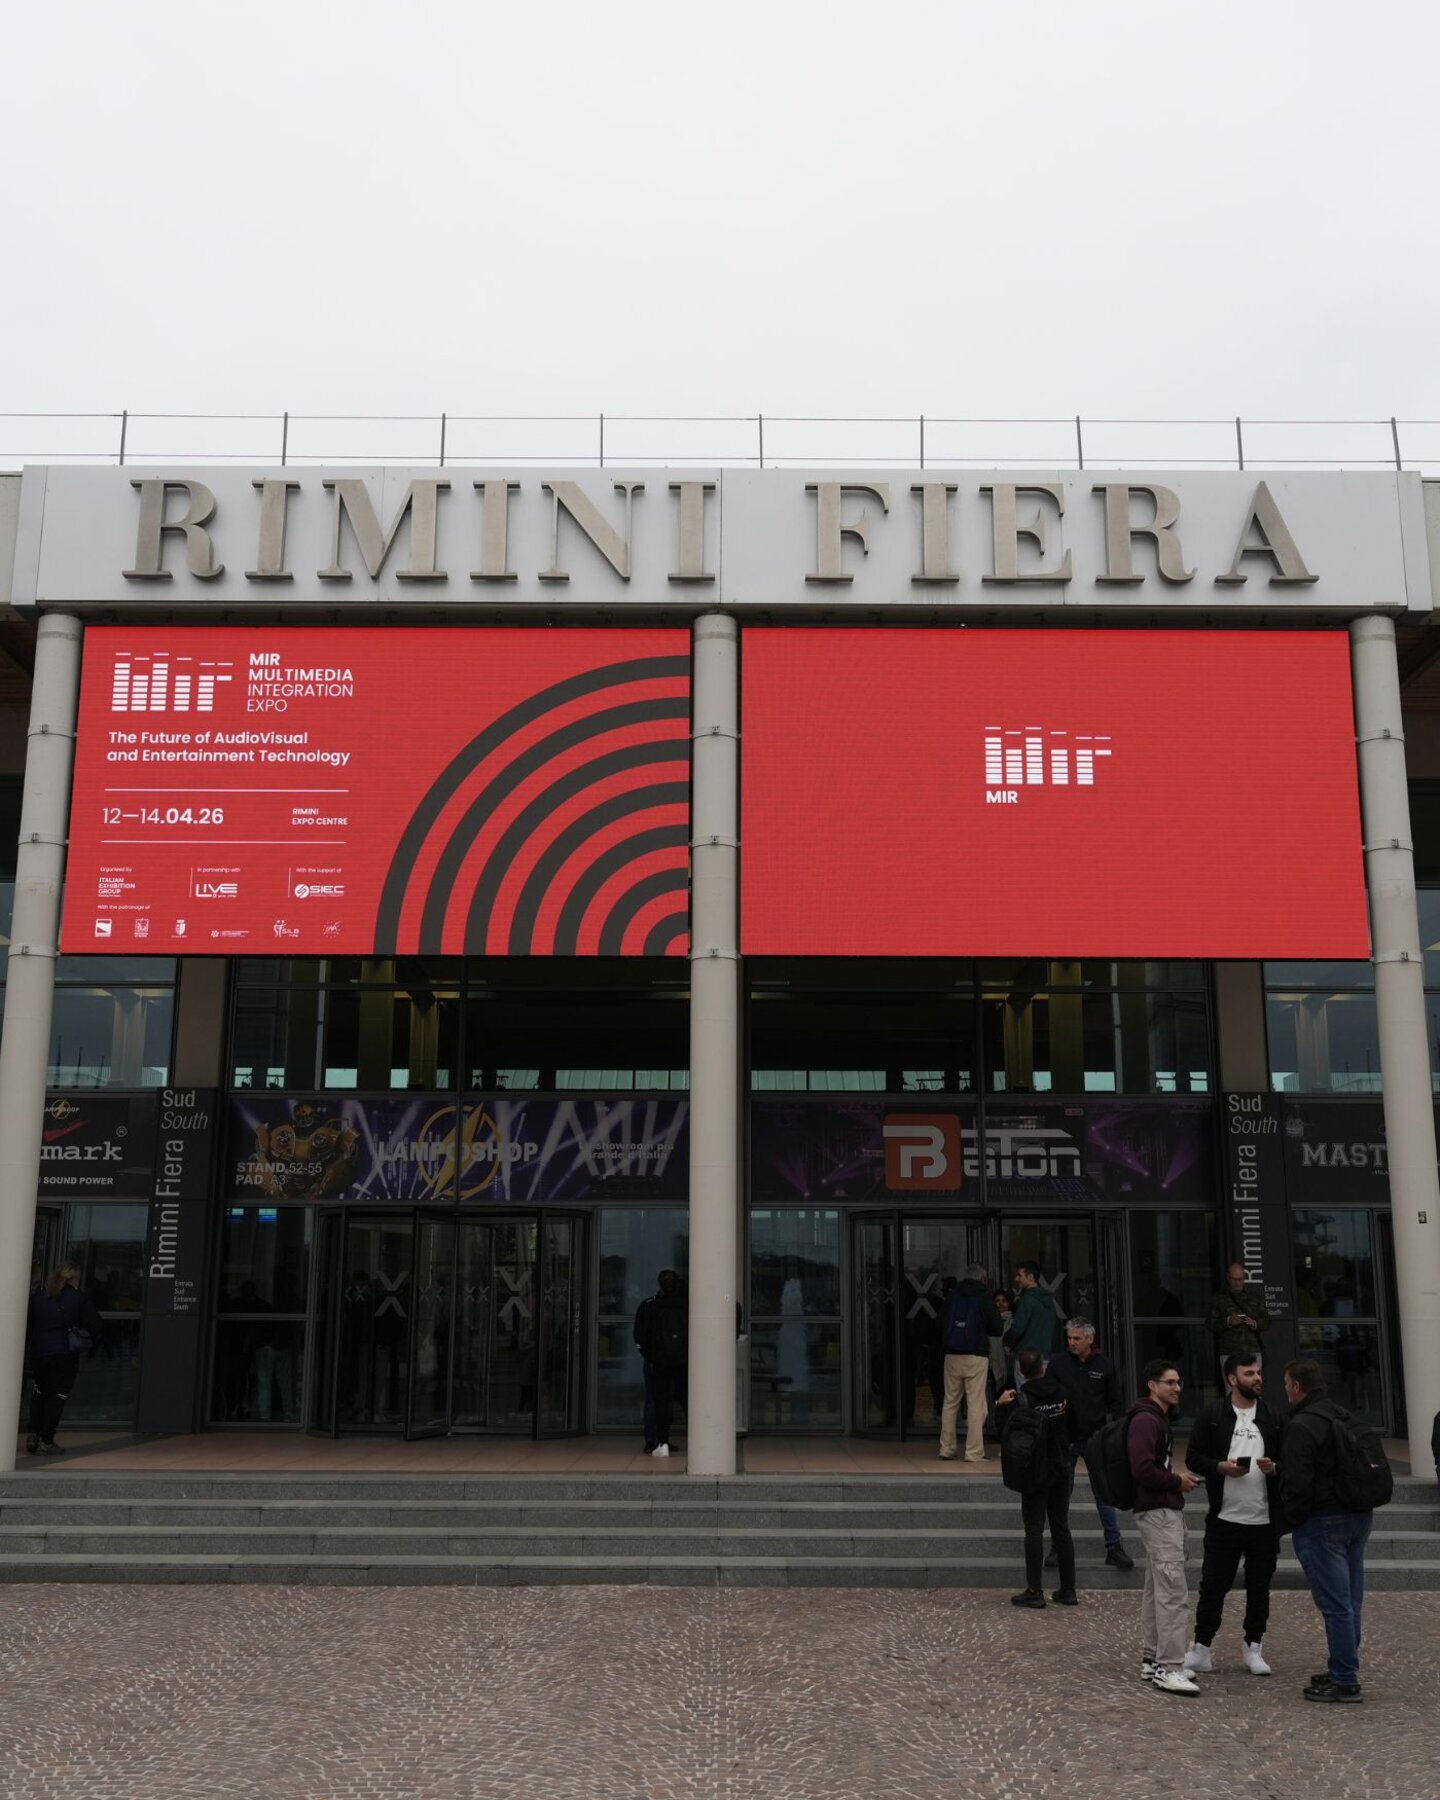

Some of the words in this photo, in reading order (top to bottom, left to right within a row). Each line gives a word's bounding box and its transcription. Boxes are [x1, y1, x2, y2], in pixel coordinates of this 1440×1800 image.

[122, 479, 716, 581] RIMINI
[805, 481, 1319, 584] FIERA
[249, 653, 280, 666] MIR
[248, 668, 353, 681] MULTIMEDIA
[247, 684, 353, 697] INTEGRATION
[247, 699, 287, 712] EXPO
[109, 731, 137, 744] The
[141, 731, 191, 744] Future
[195, 731, 211, 744] of
[214, 731, 308, 744] AudioVisual
[106, 749, 138, 762] and
[142, 749, 254, 762] Entertainment
[259, 750, 350, 766] Technology
[986, 790, 1018, 804] MIR
[291, 817, 314, 825] EXPO
[316, 817, 348, 826] CENTRE
[195, 883, 238, 898] LIVE
[309, 885, 345, 894] SIEC
[161, 1089, 196, 1108] Sud
[1228, 1094, 1262, 1112] Sud
[160, 1111, 209, 1130] South
[1230, 1115, 1278, 1134] South
[155, 1138, 184, 1196] Fiera
[289, 1162, 323, 1174] 52-55
[1233, 1144, 1259, 1202] Fiera
[43, 1176, 78, 1185] SOUND
[79, 1176, 114, 1185] POWER
[270, 1174, 286, 1185] A3
[150, 1203, 179, 1278] Rimini
